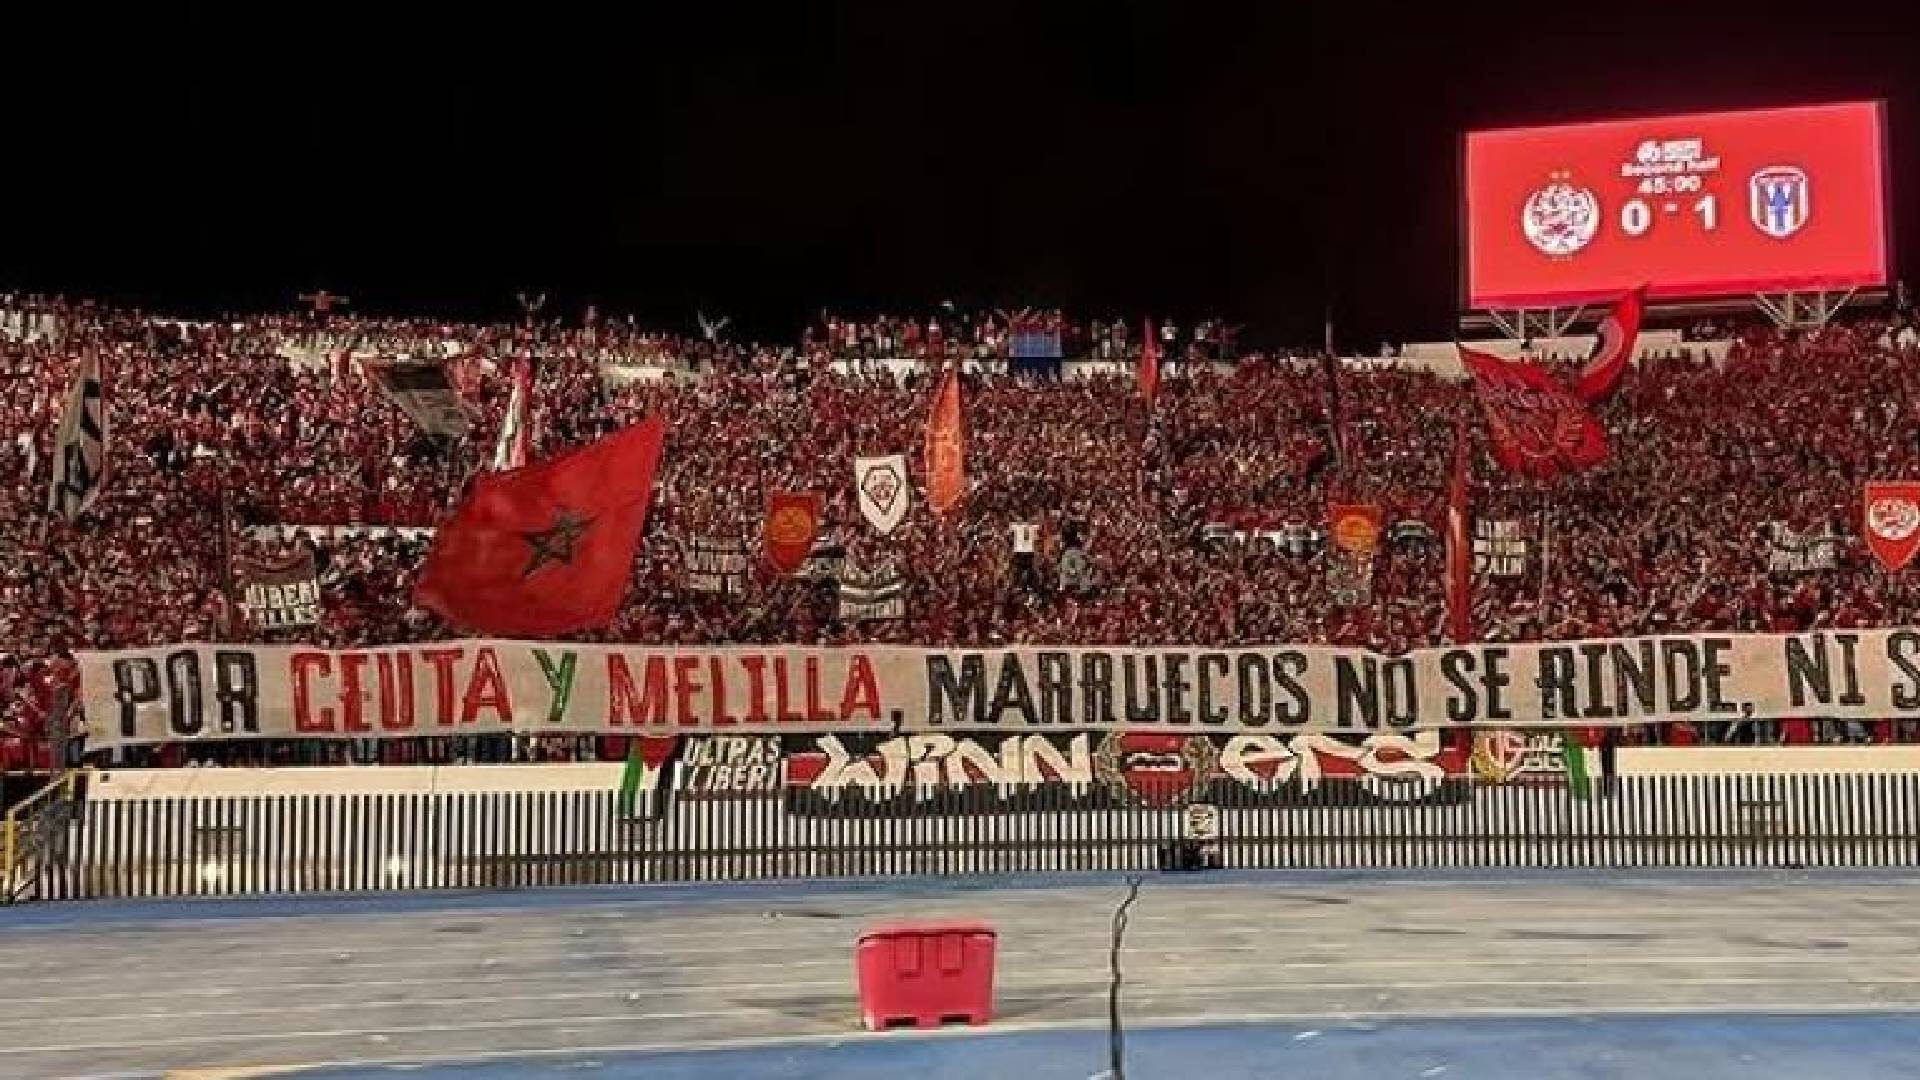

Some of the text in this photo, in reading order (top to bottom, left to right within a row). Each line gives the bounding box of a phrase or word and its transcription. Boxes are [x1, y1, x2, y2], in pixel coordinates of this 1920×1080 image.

[1621, 198, 1651, 235] 0
[1694, 194, 1716, 230] 1
[113, 649, 260, 736] POR
[290, 647, 512, 732] CEUTA
[532, 649, 577, 722] Y
[606, 652, 903, 737] MELILLA,
[926, 651, 1310, 724] MARRUECOS
[1334, 655, 1418, 727] NO
[1440, 647, 1510, 722] SE
[1534, 639, 1753, 719] RINDE,
[1784, 634, 1865, 707] NI
[683, 736, 781, 766] ULTRAS
